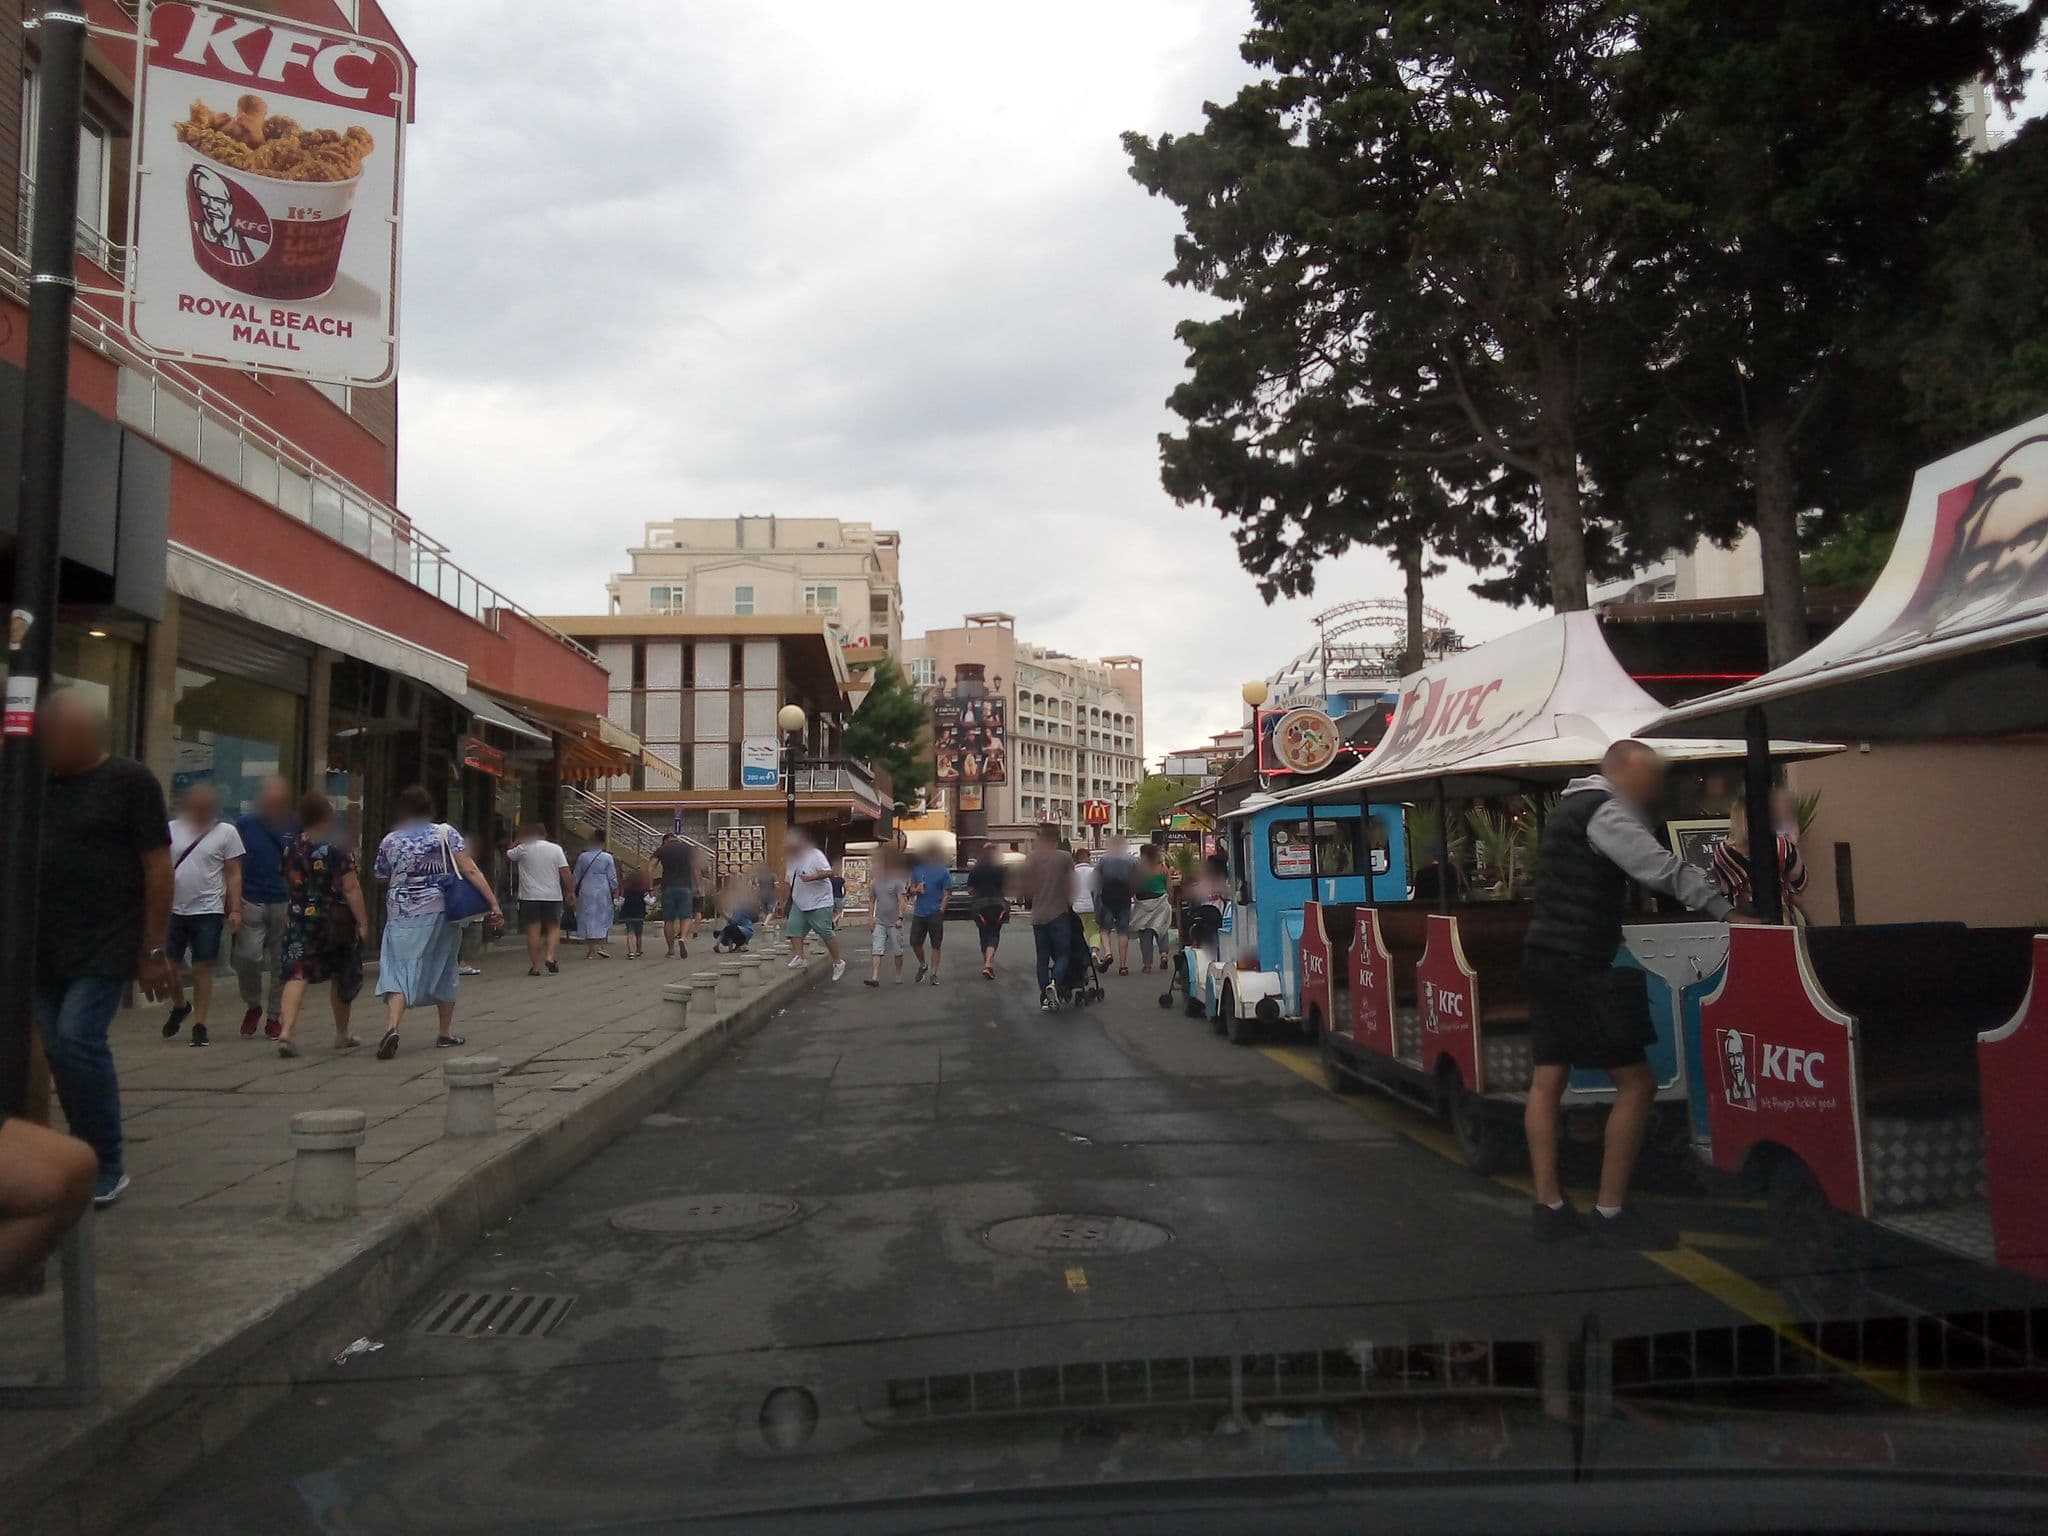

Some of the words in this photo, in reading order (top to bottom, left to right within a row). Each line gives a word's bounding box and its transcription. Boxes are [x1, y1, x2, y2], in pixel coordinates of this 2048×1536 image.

[173, 6, 377, 99] KFC
[234, 218, 269, 234] KFC
[287, 206, 323, 220] It's
[178, 294, 263, 324] ROYAL
[269, 309, 353, 338] BEACH
[232, 324, 301, 351] MALL
[1426, 678, 1504, 740] KFC
[1310, 954, 1323, 975] KFC
[1360, 968, 1374, 988] KFC
[1439, 989, 1463, 1017] KFC
[1760, 1043, 1825, 1089] KFC
